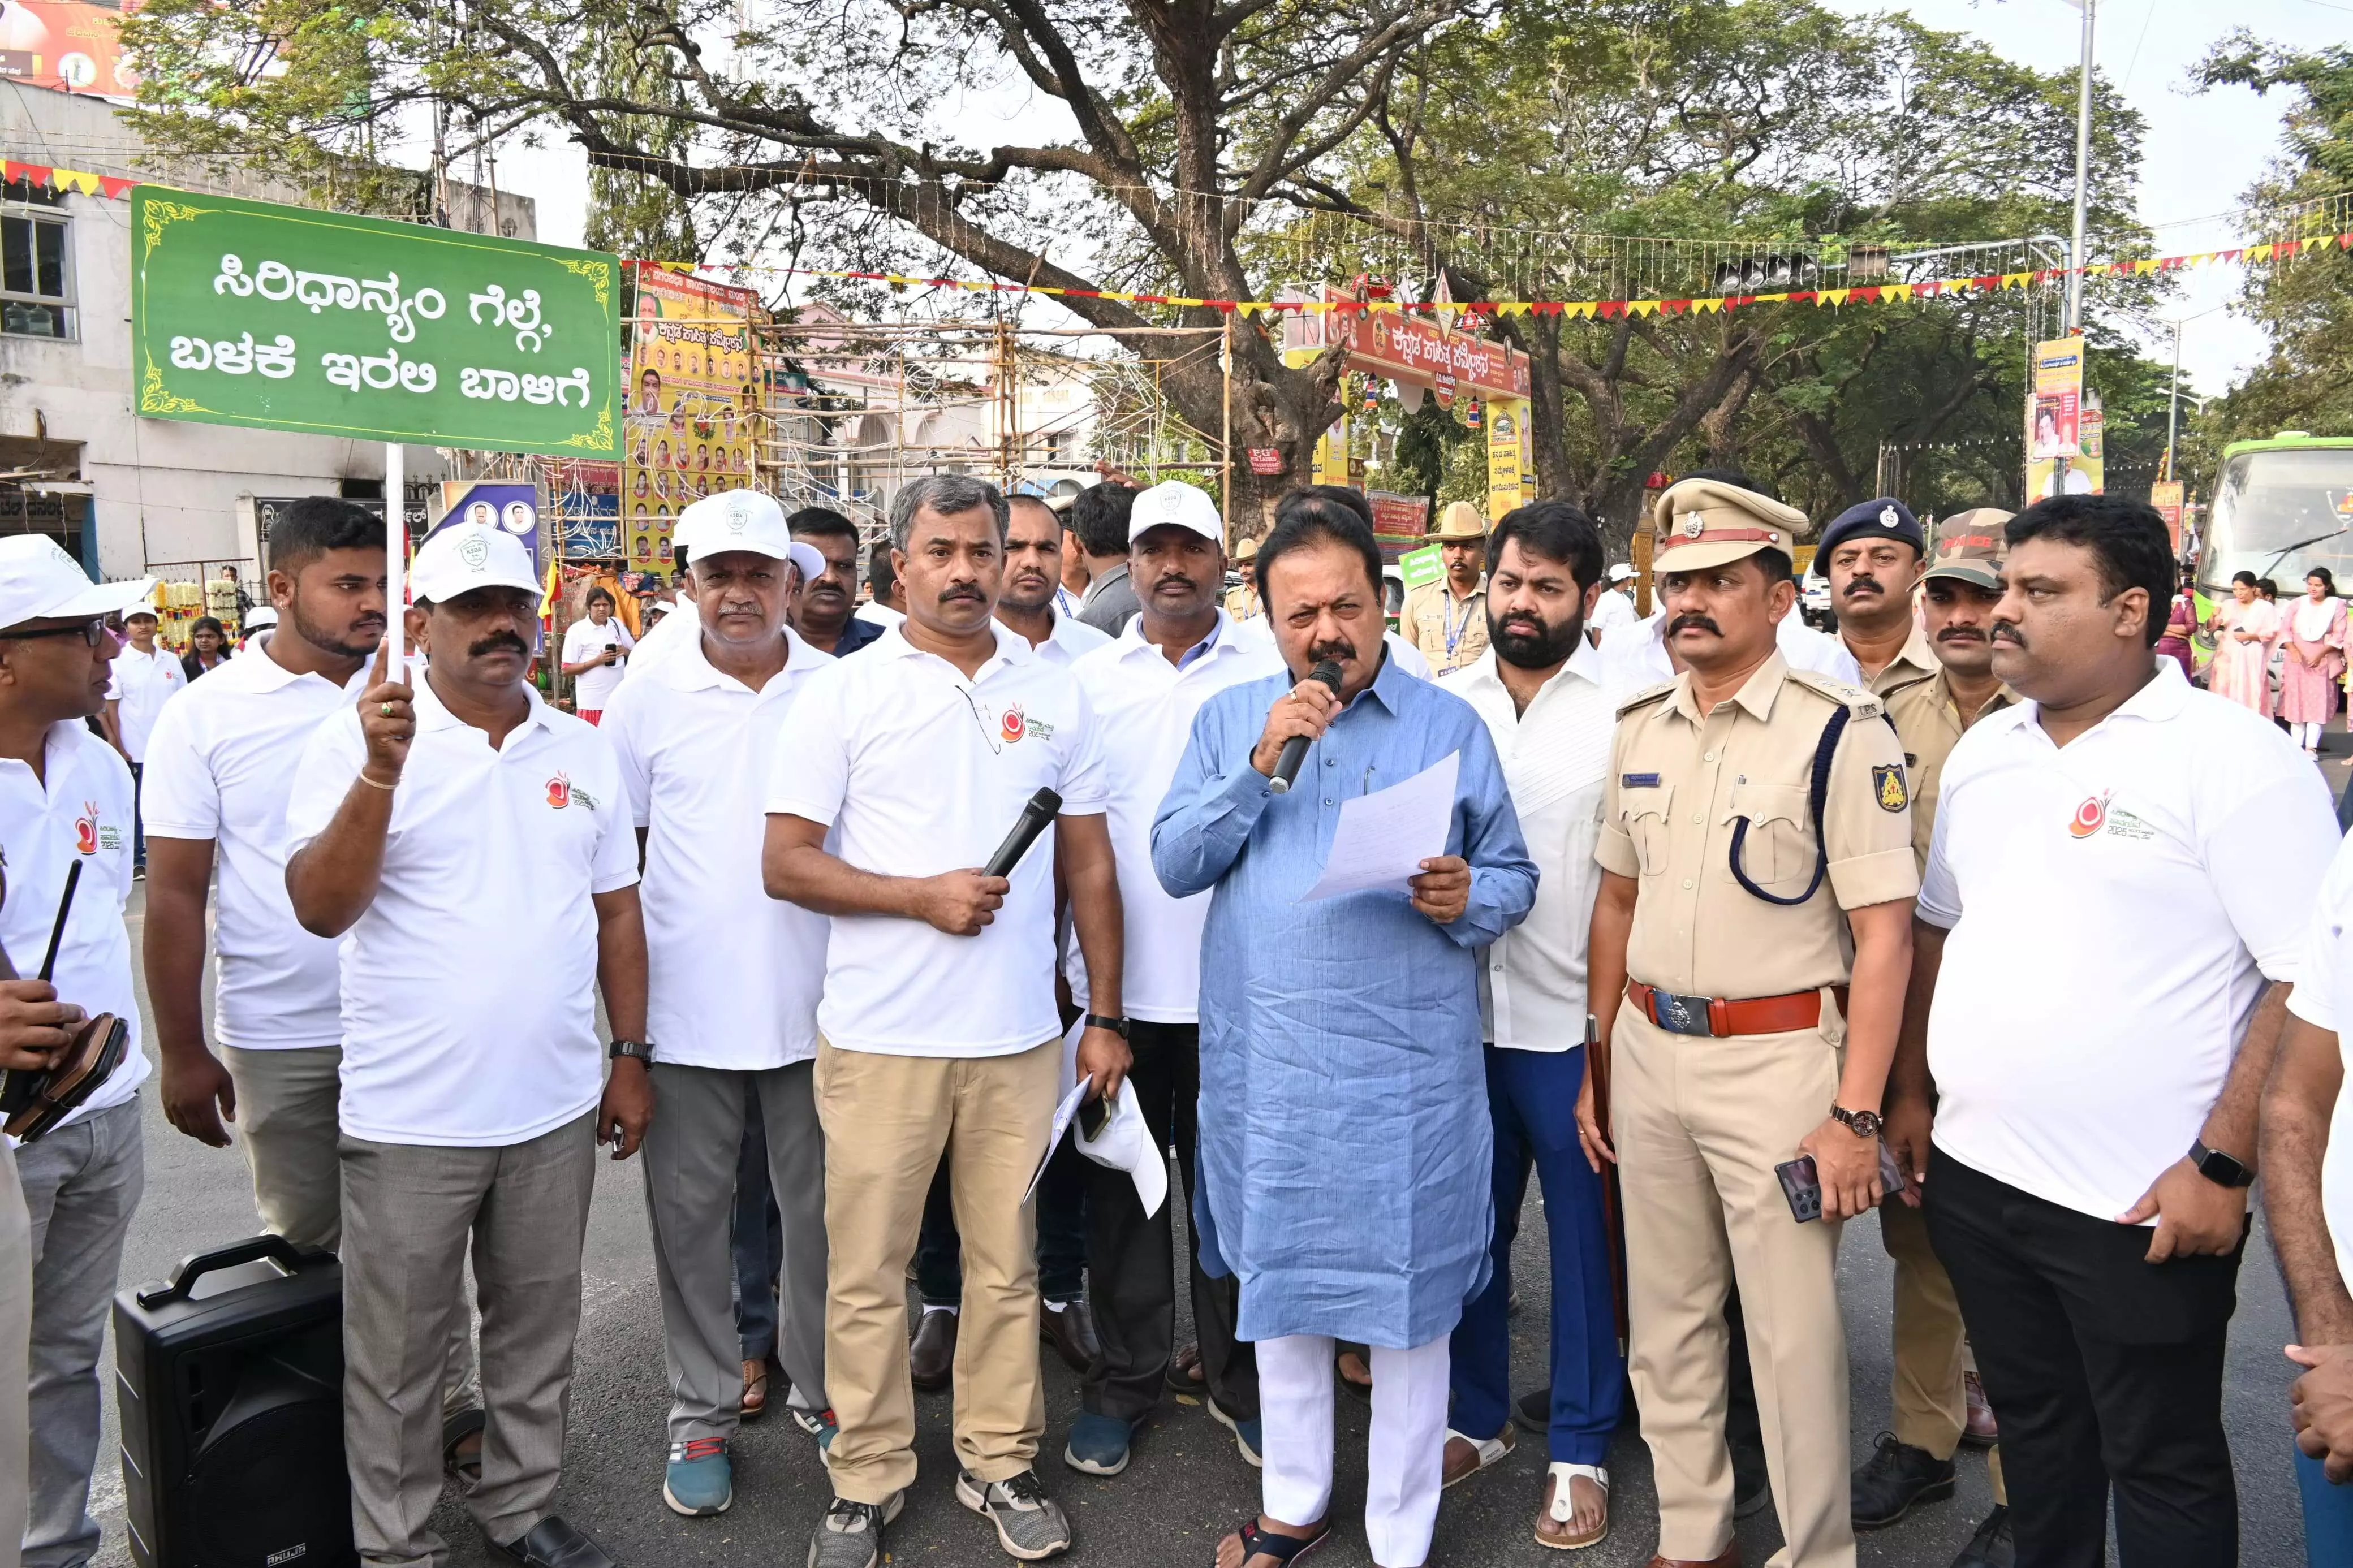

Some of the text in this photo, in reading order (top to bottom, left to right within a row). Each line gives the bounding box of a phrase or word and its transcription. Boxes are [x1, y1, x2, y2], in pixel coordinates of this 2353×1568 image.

[214, 254, 552, 353] ಸಿರಿಧಾನ್ಯಂ ಗೆಲ್ಗೆ,
[659, 322, 743, 353] ಕನ್ನಡ ಸಾಹಿತ್ಯ ಸಮ್ಮೇಳನ
[1392, 326, 1421, 366] ಕನ್ನಡ
[1423, 338, 1451, 373] ಸಾಹಿತ್ಯ
[1453, 342, 1489, 381] ಸಮ್ಮೇಳನ
[171, 332, 590, 408] ಬಳಕೆ ಇರಲಿ ಬಾಳಿಗೆ
[1492, 449, 1516, 461] ಕನ್ನಡ ಸಾಹಿತ್ಯ
[1942, 534, 1992, 550] POLICE
[2108, 826, 2127, 836] 2025
[267, 1545, 306, 1565] AHUJA
